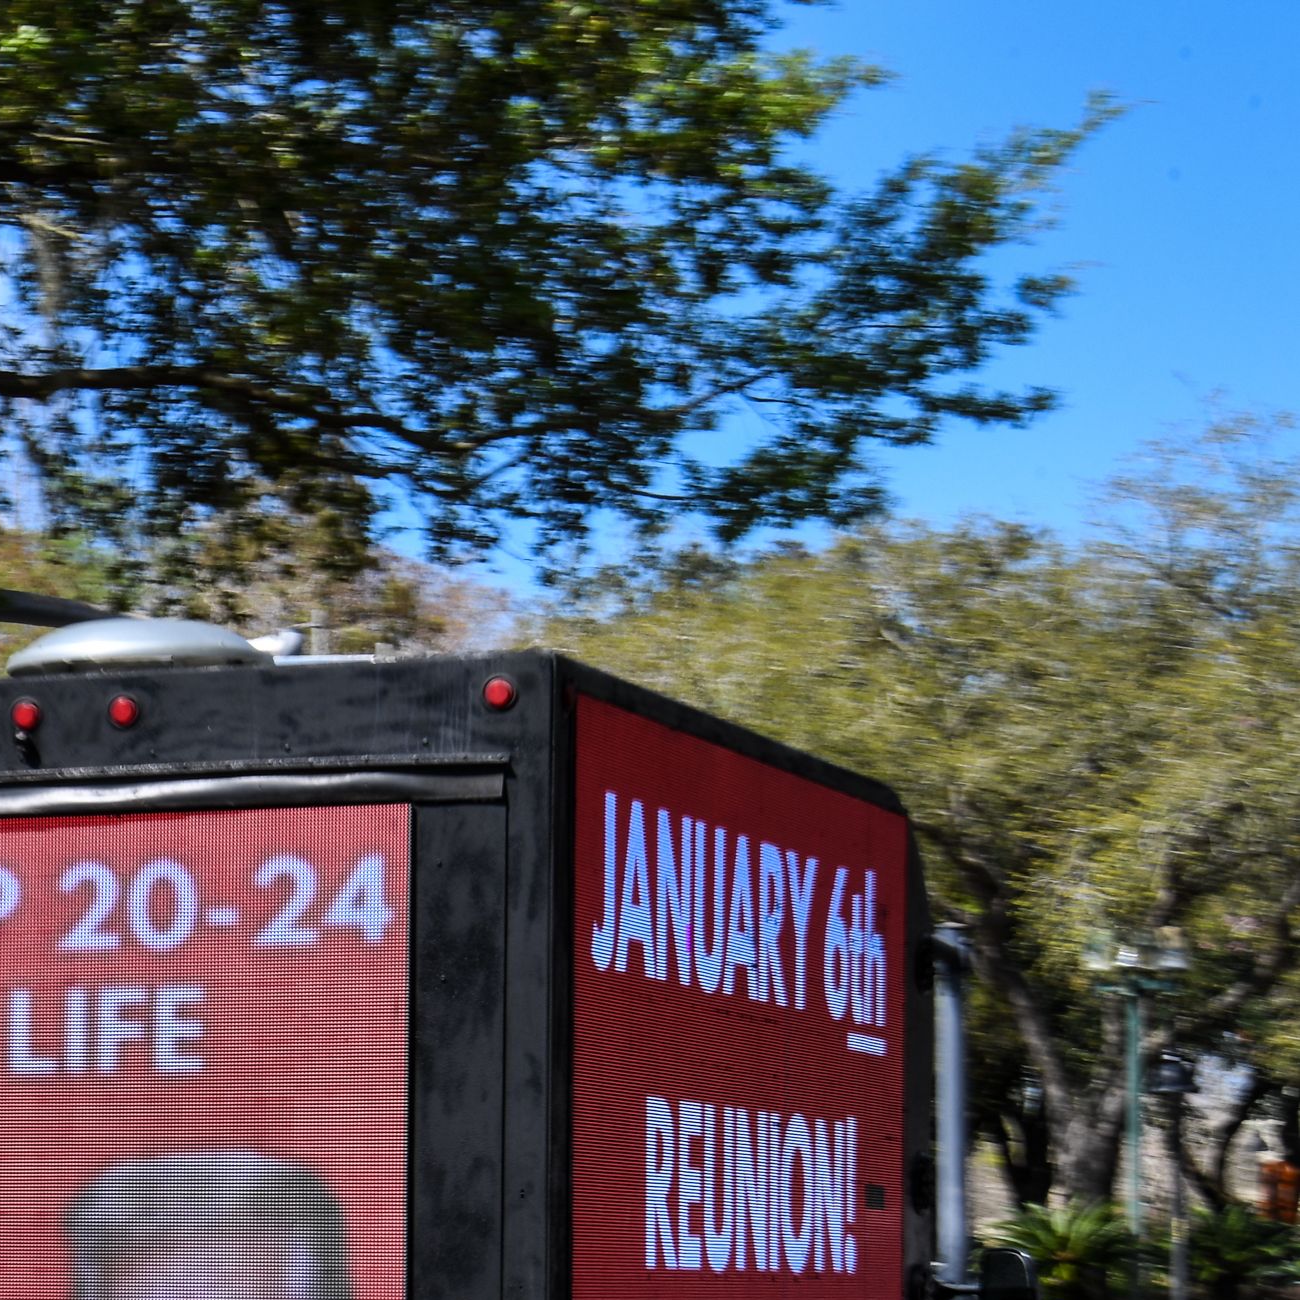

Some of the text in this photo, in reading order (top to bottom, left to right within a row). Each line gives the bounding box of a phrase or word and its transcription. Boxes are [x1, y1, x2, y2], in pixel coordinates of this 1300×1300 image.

[591, 792, 887, 1029] JANUARY 6th
[7, 984, 209, 1077] LIFE
[645, 1096, 858, 1274] REUNION!
